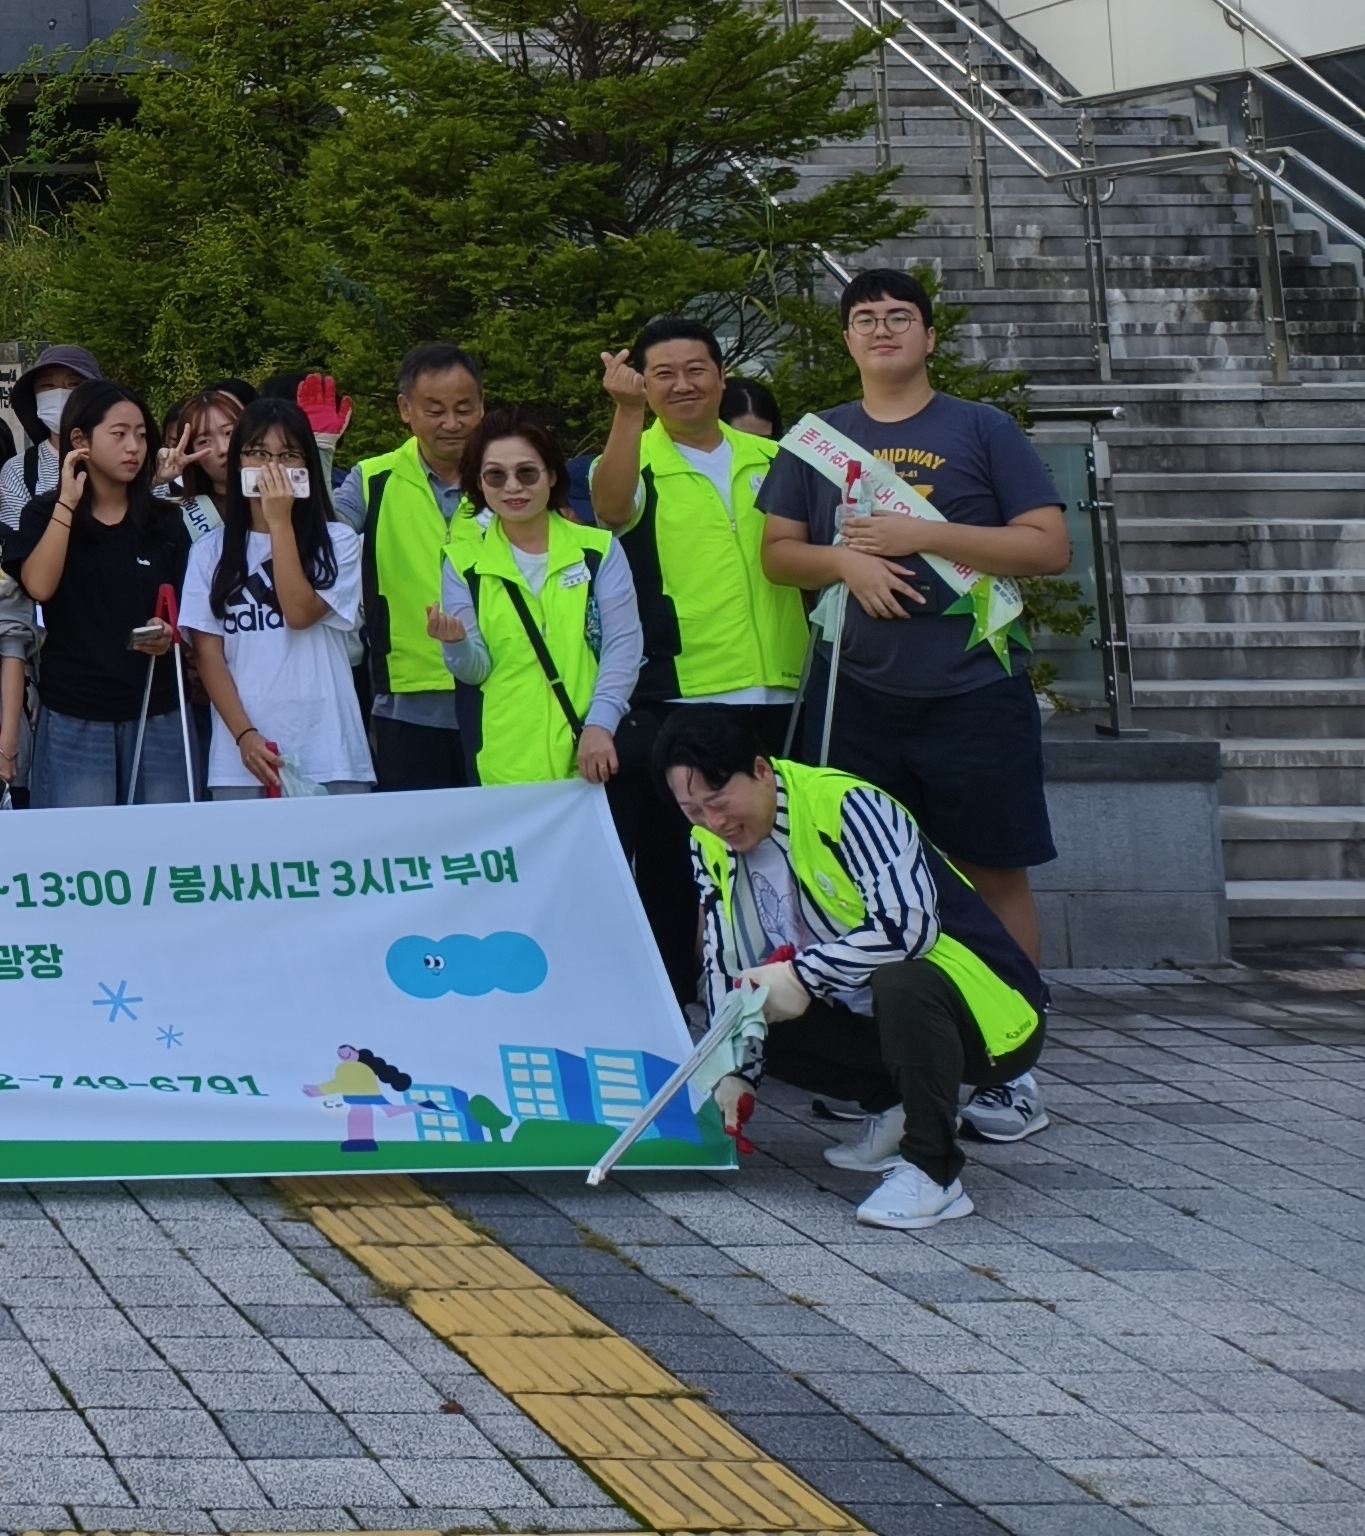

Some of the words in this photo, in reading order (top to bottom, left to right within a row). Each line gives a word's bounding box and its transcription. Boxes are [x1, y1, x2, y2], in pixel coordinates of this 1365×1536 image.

[873, 447, 946, 471] MIDWAY
[168, 862, 320, 905] 봉사시간
[331, 856, 432, 899] 3시간
[441, 846, 520, 891] 부여
